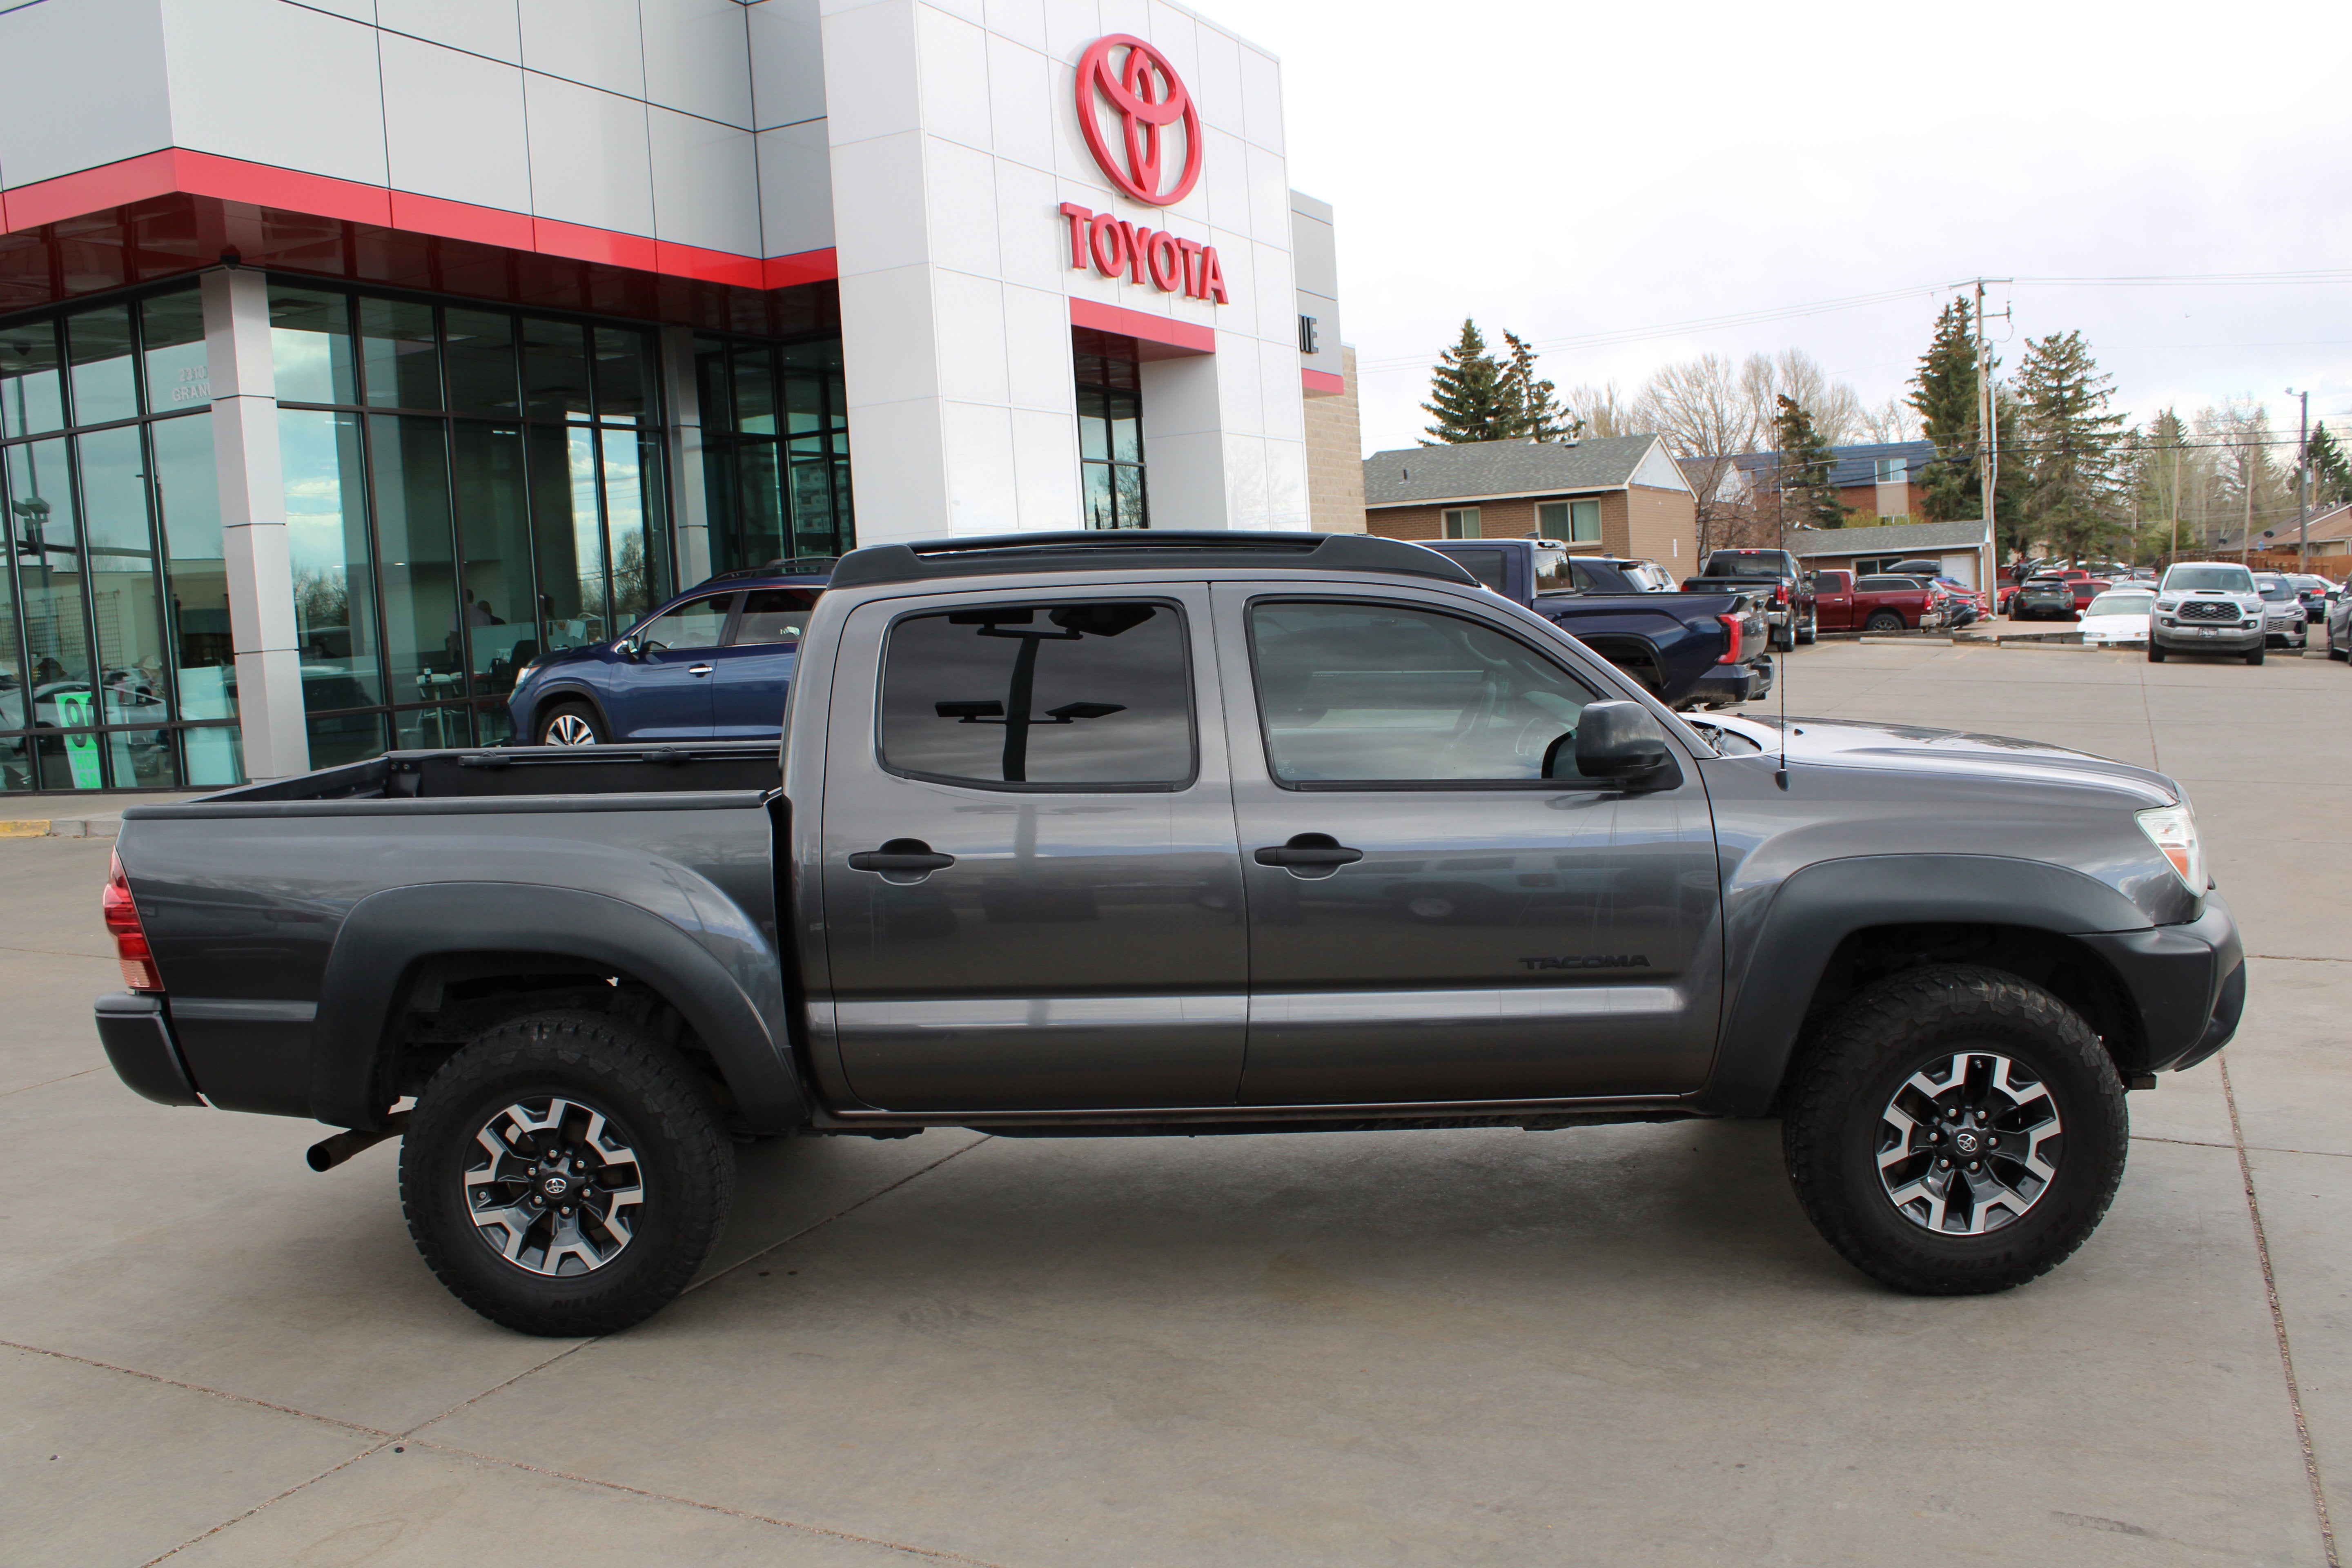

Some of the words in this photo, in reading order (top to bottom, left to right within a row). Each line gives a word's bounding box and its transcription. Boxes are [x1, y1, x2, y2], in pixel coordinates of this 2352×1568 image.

[1060, 203, 1228, 304] TOYOTA
[178, 365, 205, 381] 2310
[172, 382, 211, 401] GRAN
[1518, 955, 1651, 969] TACOMA
